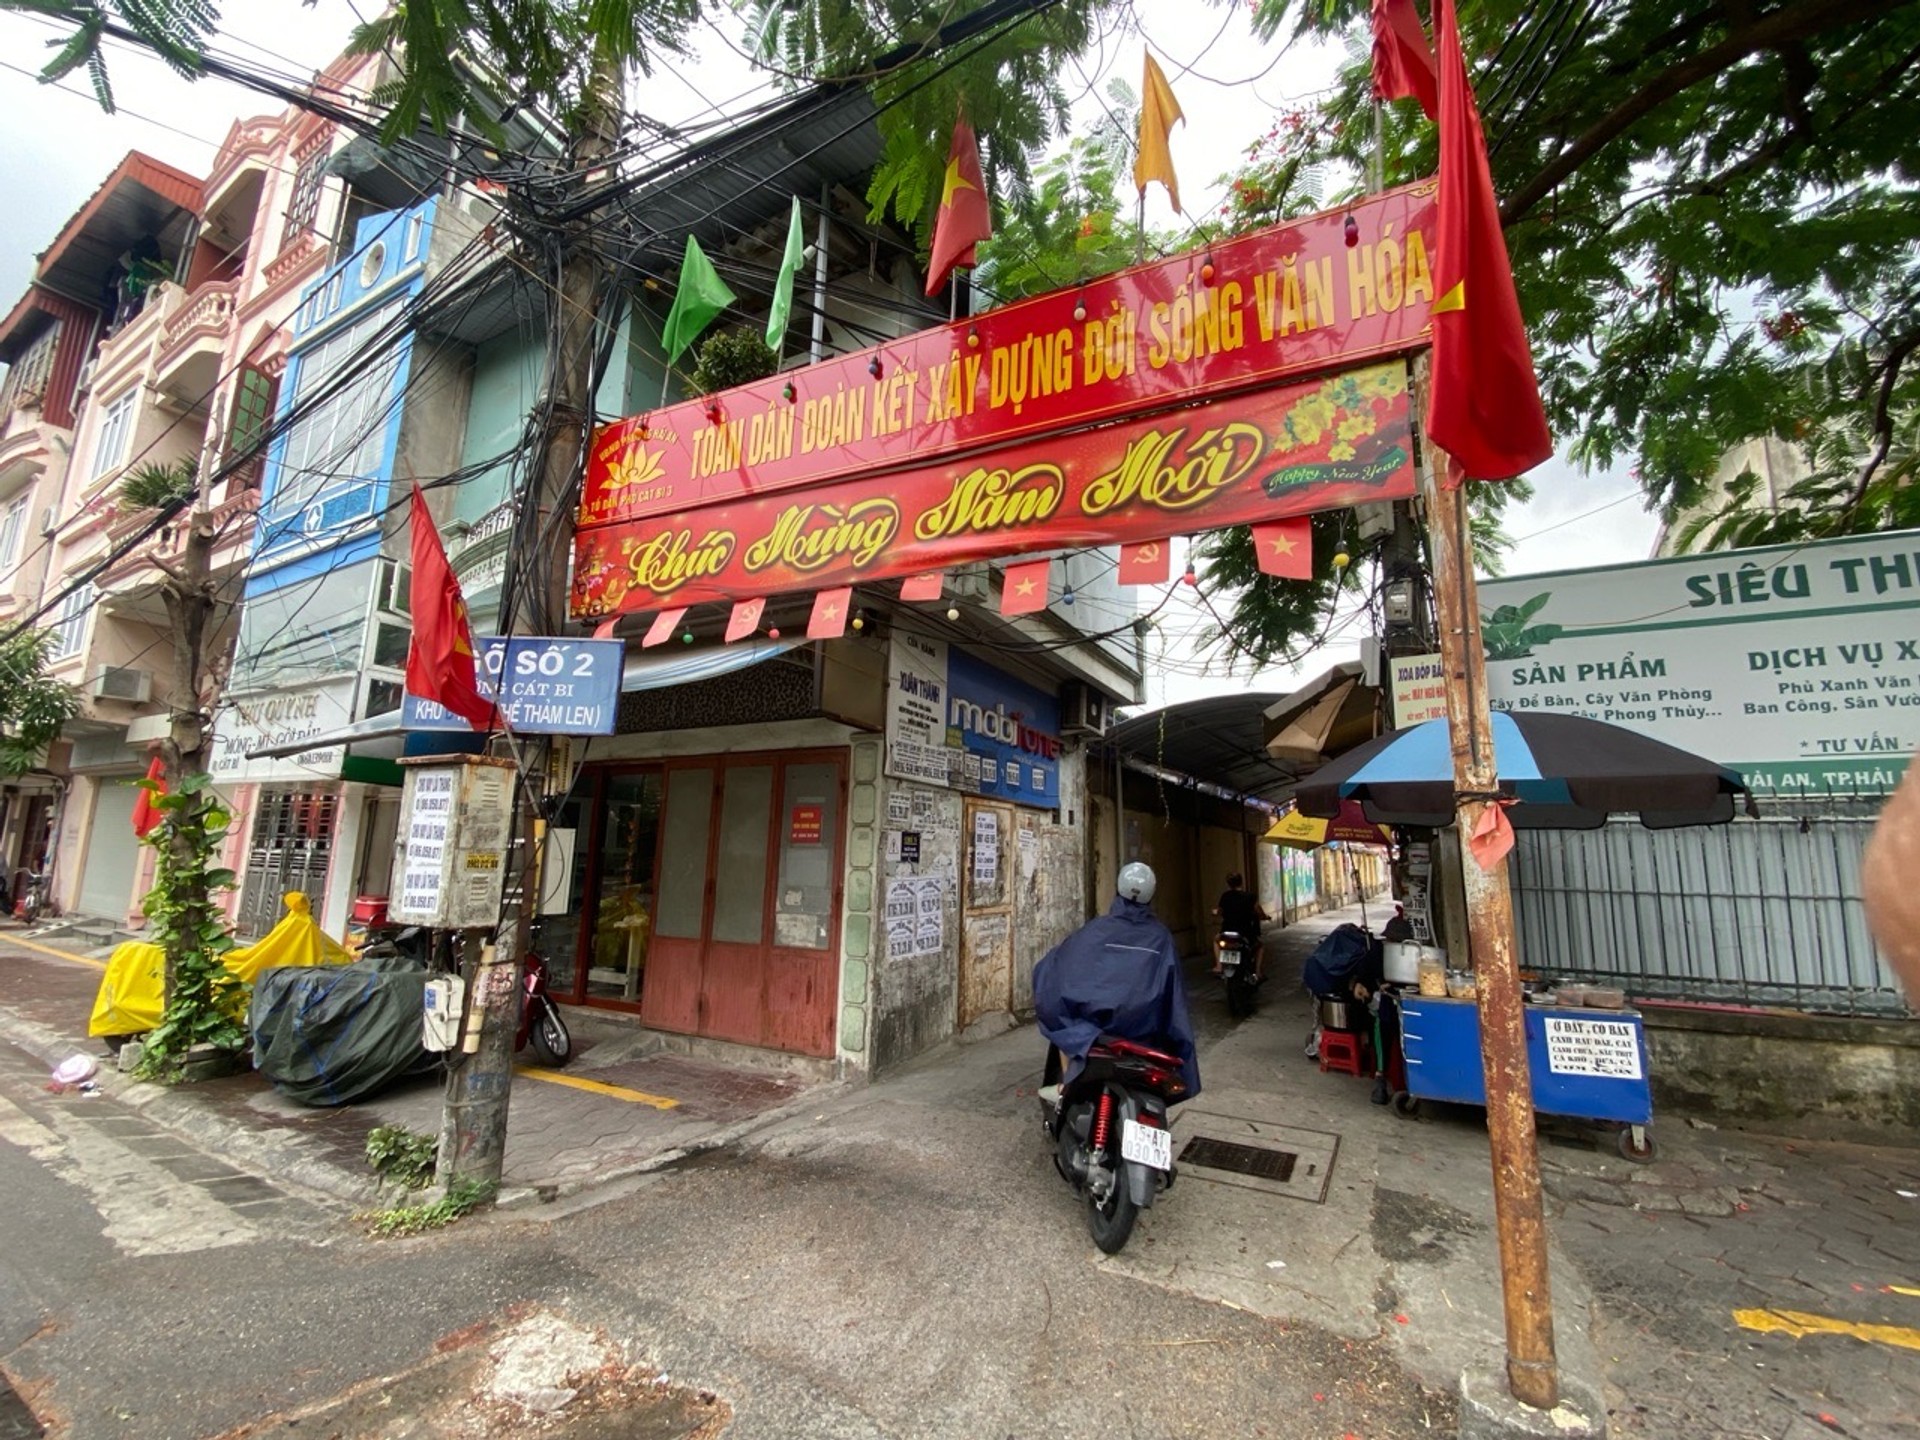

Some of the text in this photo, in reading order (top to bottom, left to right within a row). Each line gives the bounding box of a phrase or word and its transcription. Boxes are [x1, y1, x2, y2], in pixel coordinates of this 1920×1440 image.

[690, 226, 1434, 480] TOÀN DÂN ĐOÀN KẾT XÂY DỰNG ĐỜI SỐNG VĂN HÓA
[1269, 465, 1321, 493] Happy
[1323, 468, 1359, 479] New
[628, 422, 1265, 594] Chúc Mừng Năm Mới
[1686, 562, 1811, 608] SIÊU
[515, 645, 570, 676] SỐ
[572, 653, 594, 677] 2
[1512, 650, 1667, 686] SẢN PHẨM
[1748, 647, 1827, 675] DỊCH
[1838, 642, 1883, 668] VỤ
[1398, 667, 1414, 682] XOA
[1415, 661, 1431, 680] BÓP
[512, 679, 549, 697] CÁT
[553, 684, 575, 697] BI
[1778, 674, 1911, 695] Phủ Xanh Văn
[1520, 693, 1539, 708] Để
[1544, 694, 1580, 707] Bàn,
[1586, 693, 1614, 706] Cây
[1619, 691, 1651, 703] Văn
[1657, 687, 1712, 702] Phòng
[1744, 702, 1779, 715] Ban
[1844, 693, 1879, 710] Sân
[415, 700, 442, 719] KHU
[524, 699, 561, 724] THẢM
[566, 704, 600, 728] LEN)
[1604, 709, 1657, 723] Phong
[1817, 731, 1899, 752] TƯ VẤN
[1781, 773, 1816, 788] AN,
[1822, 767, 1895, 787] TP.HẢI
